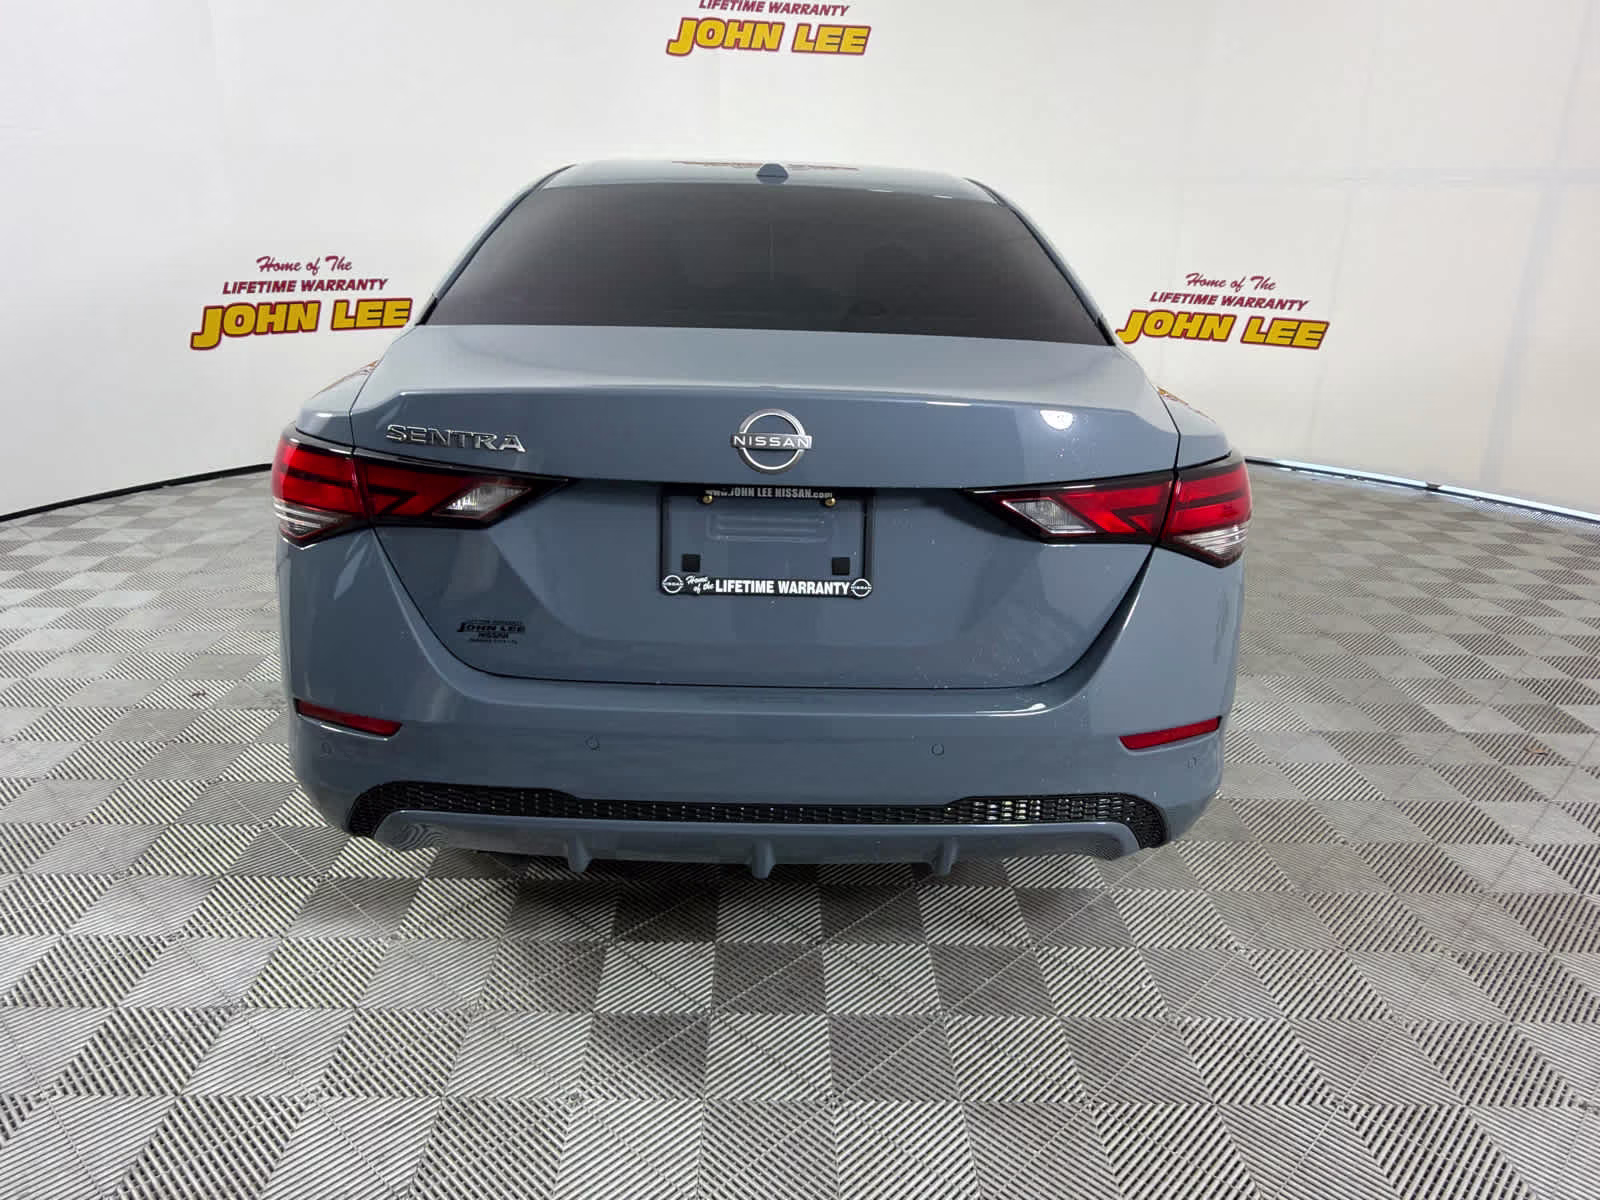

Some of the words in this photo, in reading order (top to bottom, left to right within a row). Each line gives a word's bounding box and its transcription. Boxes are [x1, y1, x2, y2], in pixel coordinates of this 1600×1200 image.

[698, 0, 765, 13] LIFETIME
[768, 2, 850, 17] WARRANTY
[666, 17, 785, 56] JOHN
[791, 22, 872, 56] LEE
[256, 256, 301, 273] Home
[305, 257, 321, 276] of
[325, 255, 353, 272] The
[222, 279, 297, 295] LIFETIME
[300, 278, 389, 293] WARRANTY
[1185, 272, 1226, 288] Home
[1230, 276, 1246, 293] of
[1250, 275, 1277, 291] The
[1149, 291, 1219, 306] LIFETIME
[1221, 294, 1310, 312] WARRANTY
[190, 300, 321, 351] JOHN
[330, 297, 413, 331] LEE
[1115, 309, 1237, 345] JOHN
[1239, 315, 1330, 351] LEE
[385, 424, 526, 453] SENTRA
[733, 435, 810, 448] NISSAN
[757, 487, 773, 497] LEE
[774, 487, 833, 499] NISSAN.com
[685, 575, 709, 585] Home
[692, 582, 701, 595] of
[702, 581, 715, 591] the
[715, 579, 775, 594] LIFETIME
[777, 580, 850, 595] WARRANTY
